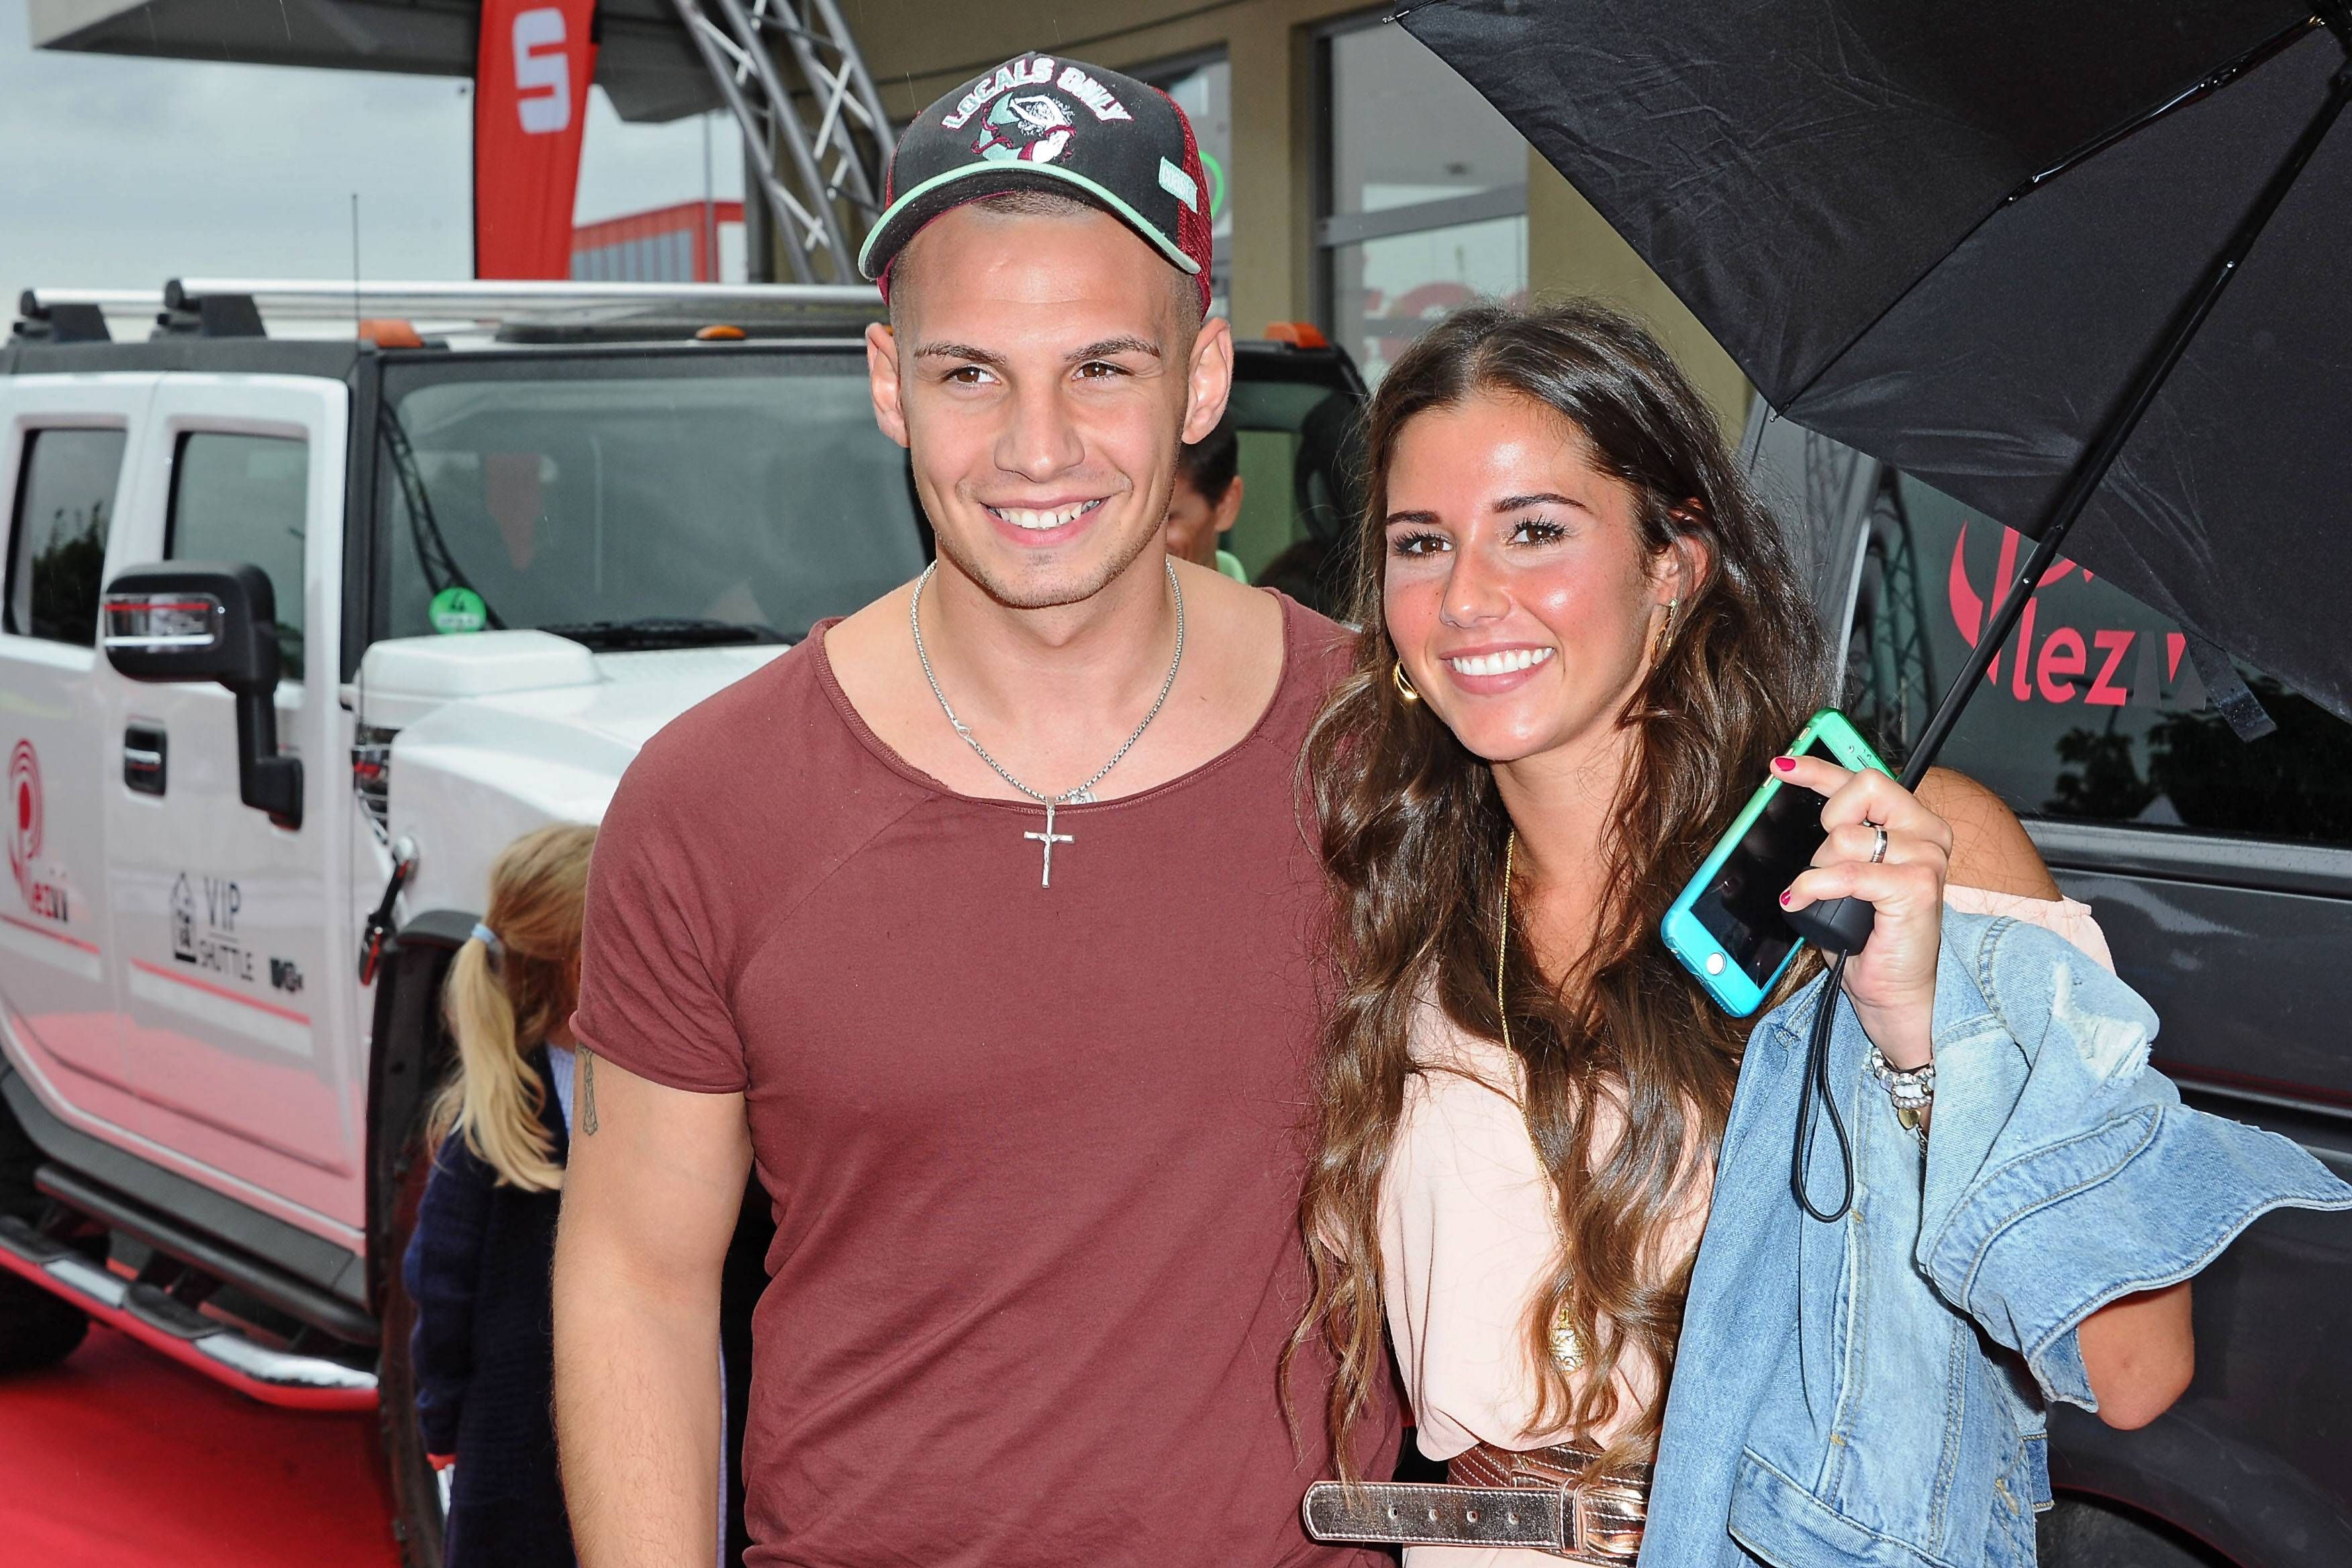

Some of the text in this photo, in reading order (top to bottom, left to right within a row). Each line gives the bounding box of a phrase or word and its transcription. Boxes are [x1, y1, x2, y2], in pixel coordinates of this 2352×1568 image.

[940, 56, 1134, 130] LOCALS ONLY
[203, 876, 242, 932] VIP
